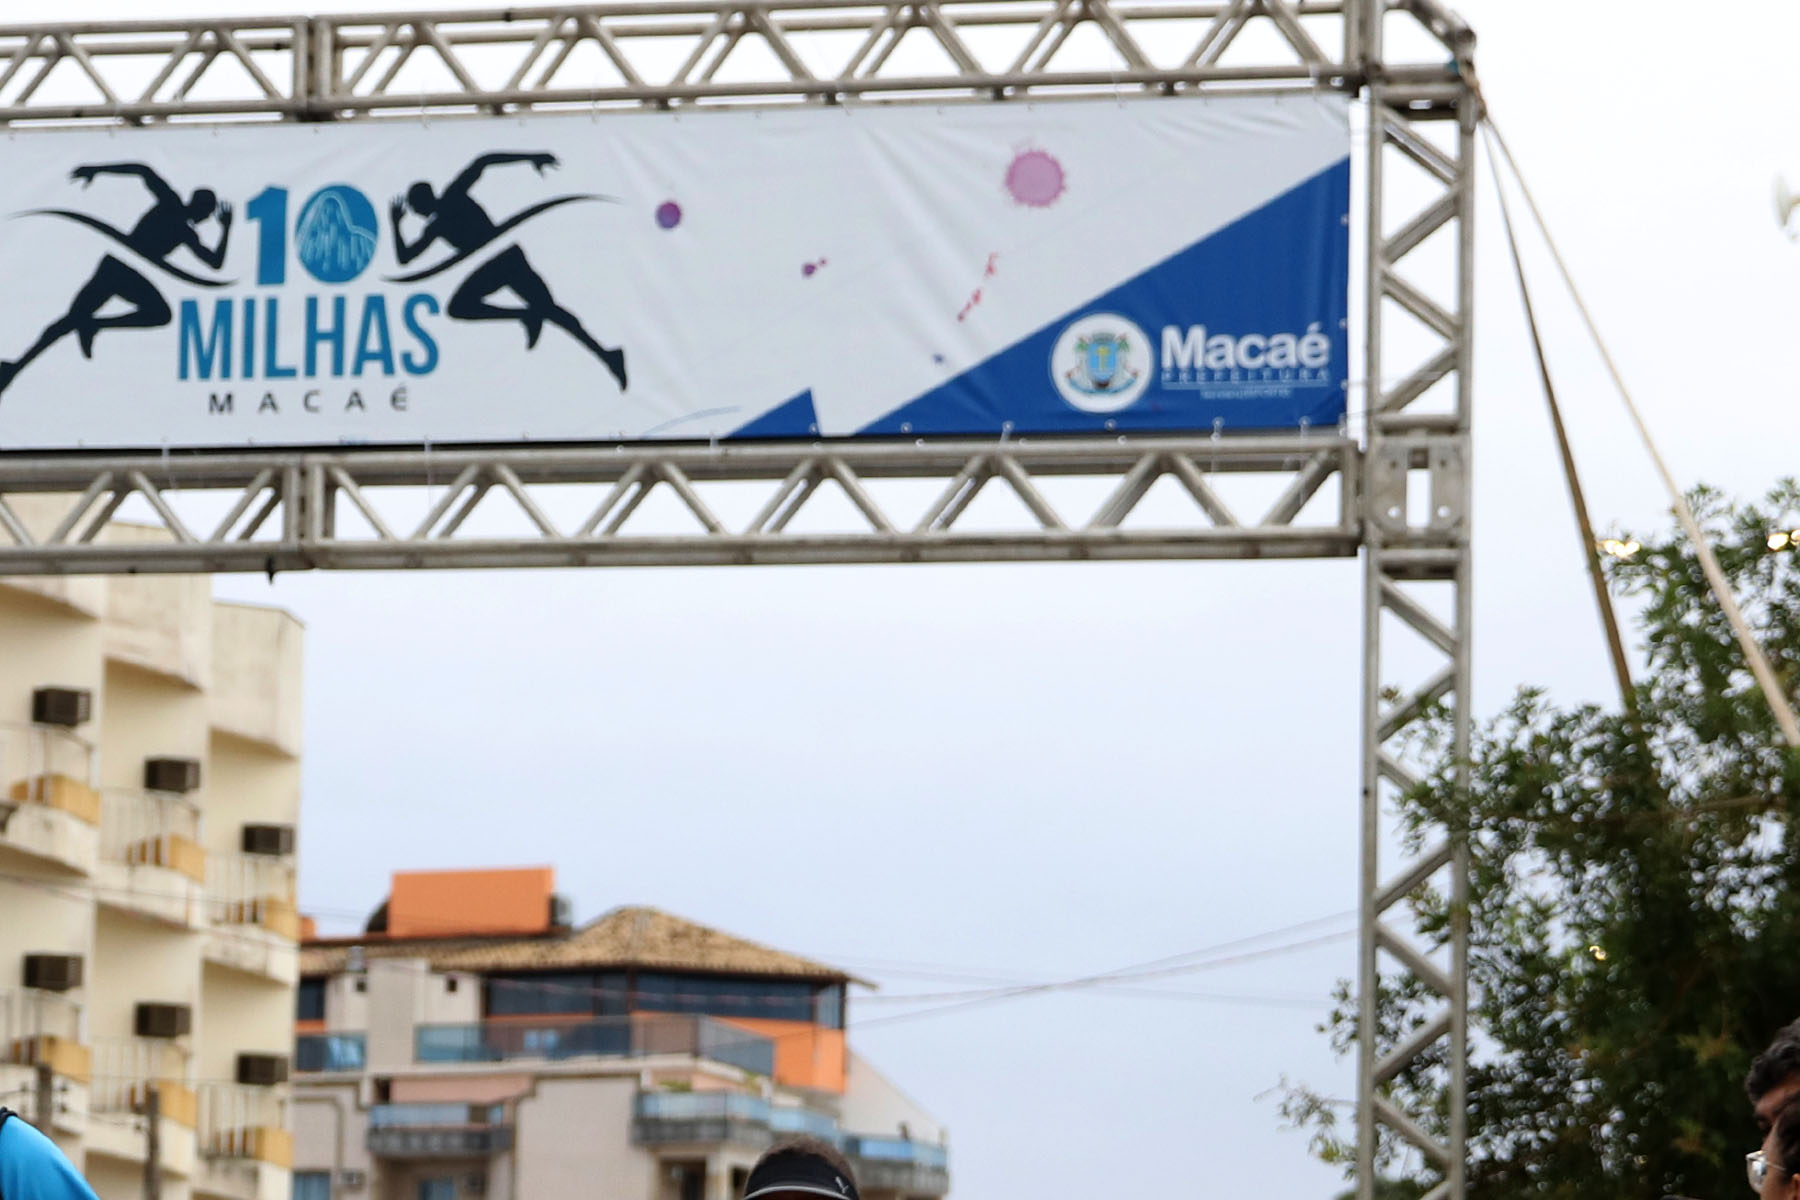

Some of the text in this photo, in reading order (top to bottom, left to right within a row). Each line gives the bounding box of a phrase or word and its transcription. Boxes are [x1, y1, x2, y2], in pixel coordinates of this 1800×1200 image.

[246, 184, 379, 286] 10
[177, 293, 439, 381] MILHAS
[1161, 322, 1331, 370] Macaé
[209, 387, 408, 415] MACAÉ
